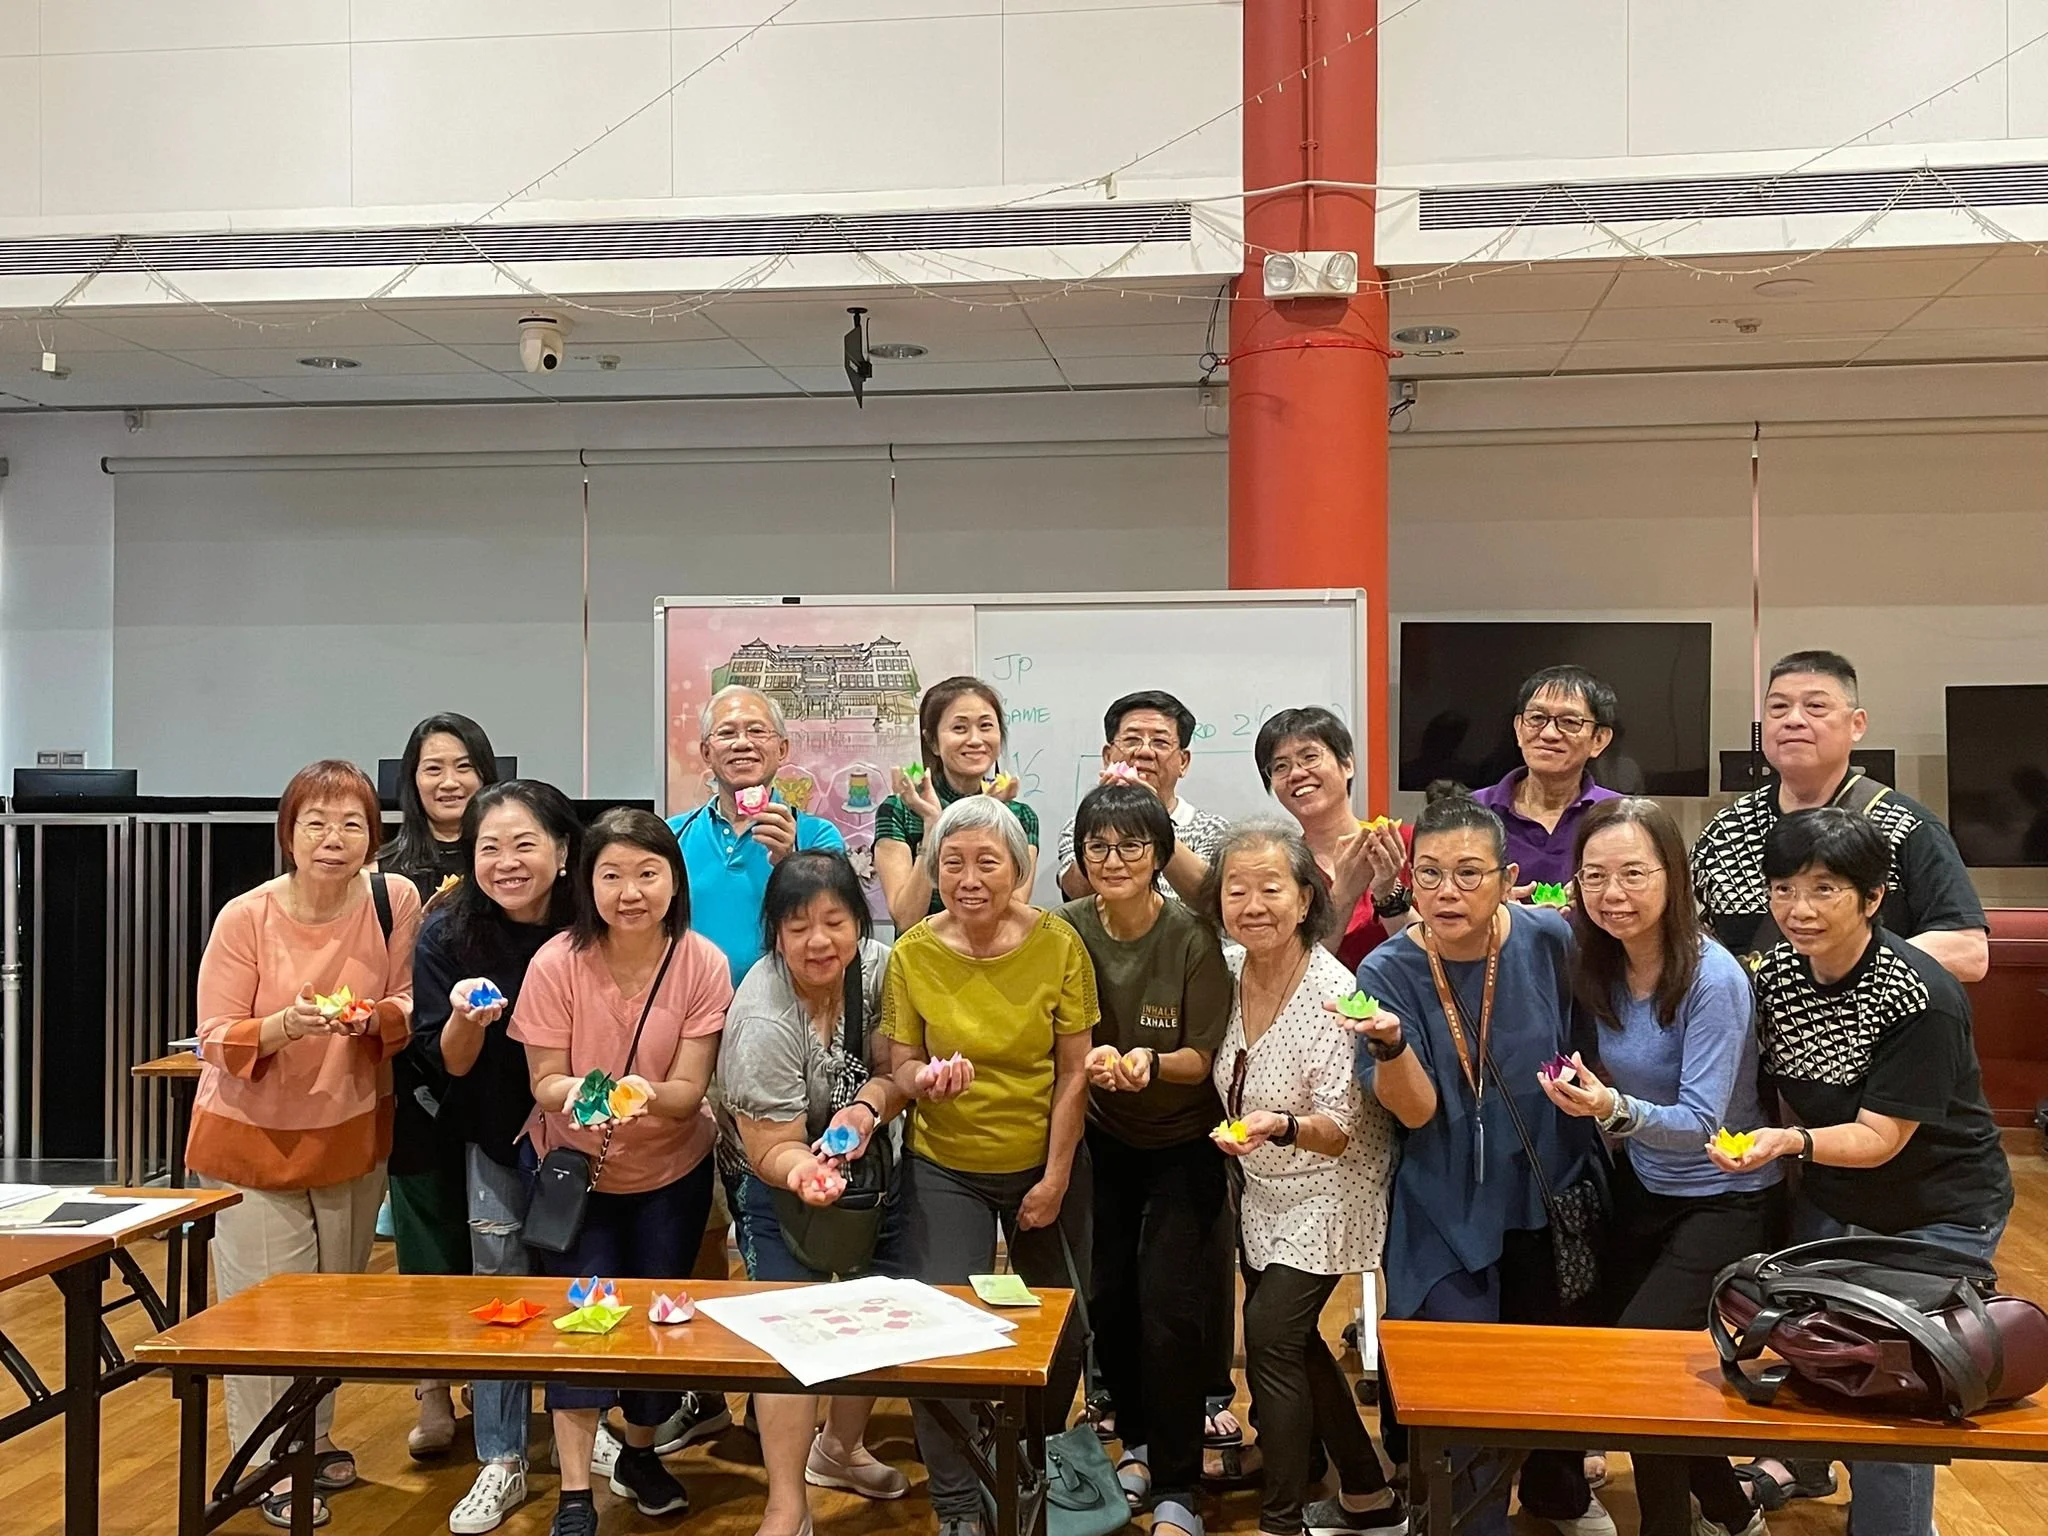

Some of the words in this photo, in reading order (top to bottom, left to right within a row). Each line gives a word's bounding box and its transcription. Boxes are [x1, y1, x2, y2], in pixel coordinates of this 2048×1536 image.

[992, 653, 1032, 685] JP
[1232, 714, 1251, 736] 2
[1142, 1004, 1177, 1016] INHALE
[1140, 1015, 1178, 1028] EXHALE
